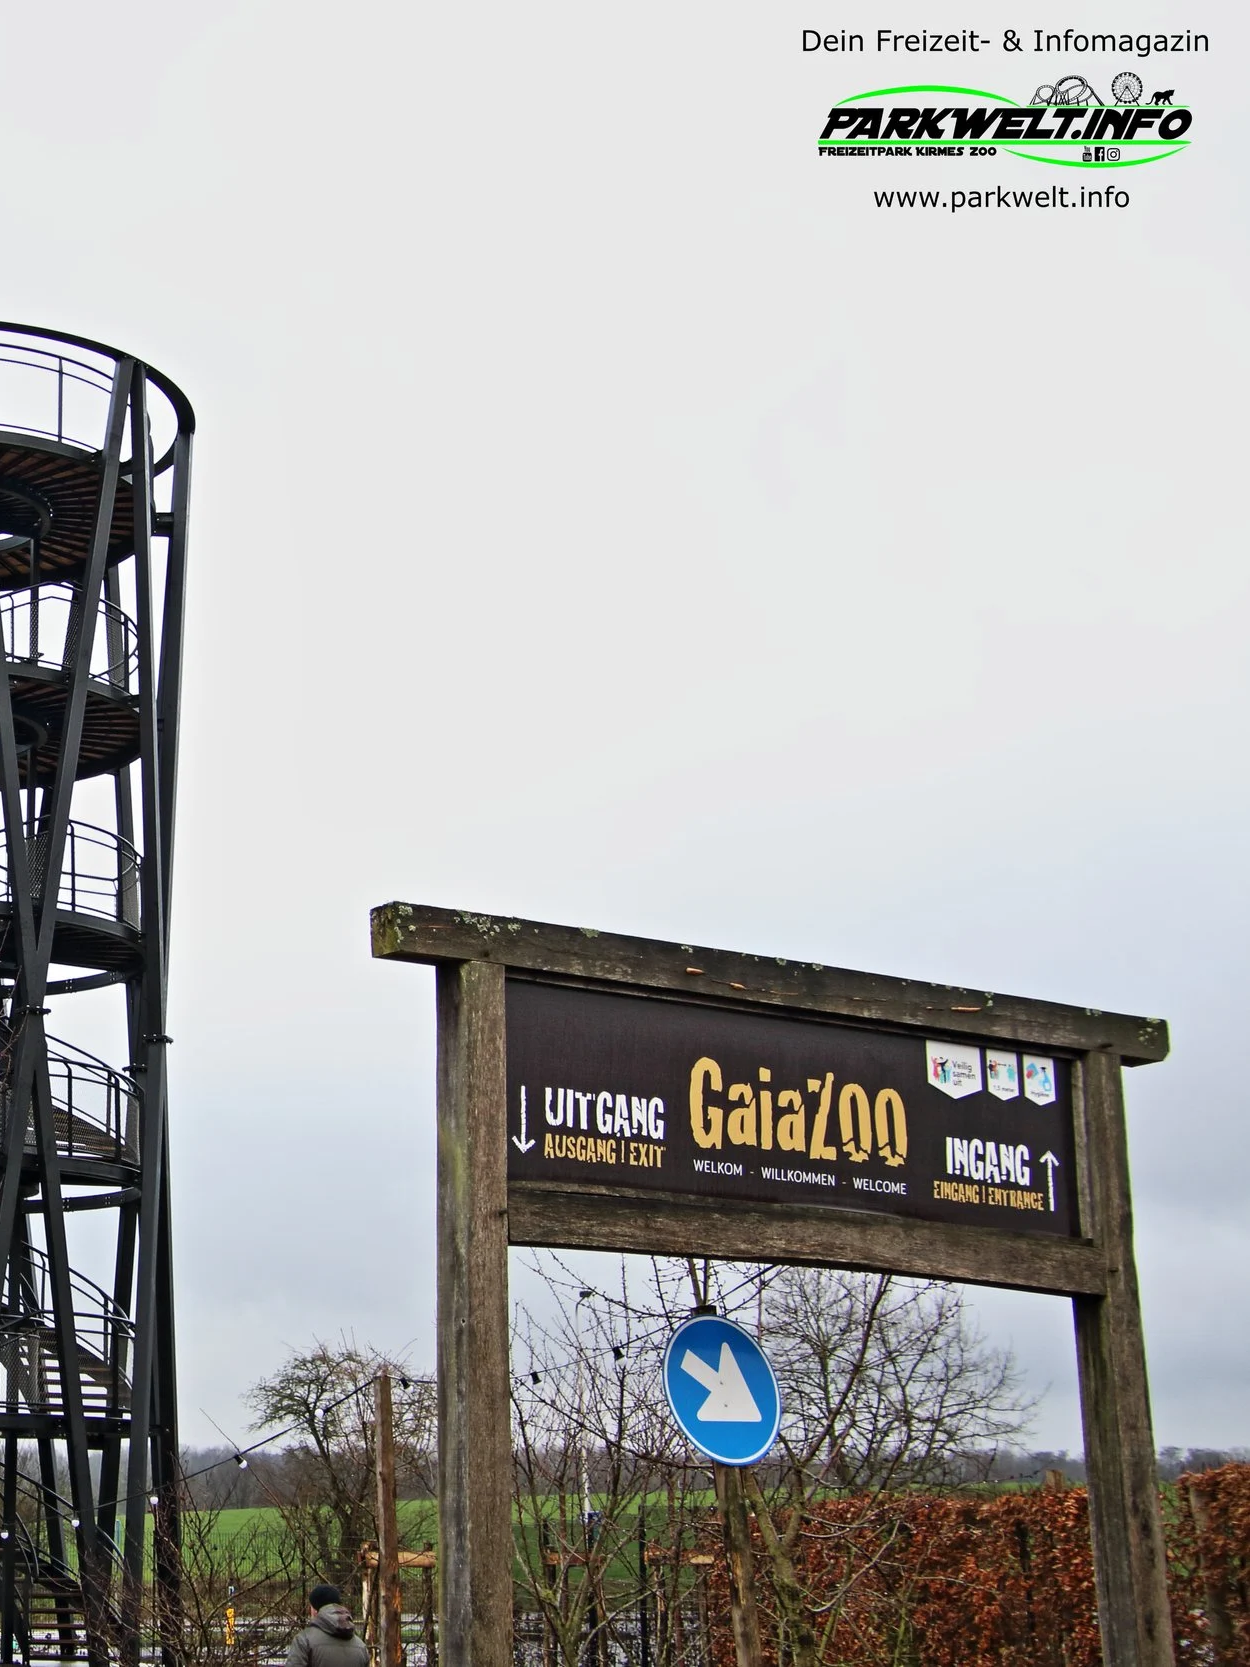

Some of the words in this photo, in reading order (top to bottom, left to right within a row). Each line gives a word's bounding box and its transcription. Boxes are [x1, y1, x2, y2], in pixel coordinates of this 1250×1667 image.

[545, 1087, 665, 1140] UITGANG
[544, 1133, 616, 1165] AUSGANG
[629, 1142, 666, 1168] EXIT
[945, 1136, 1031, 1187] INGANG
[693, 1159, 744, 1177] WELKOM
[761, 1166, 836, 1187] WILLKOMMEN
[852, 1177, 908, 1196] WELCOME
[933, 1180, 980, 1204] EINGANG
[988, 1187, 1045, 1211] ENTRANCE
